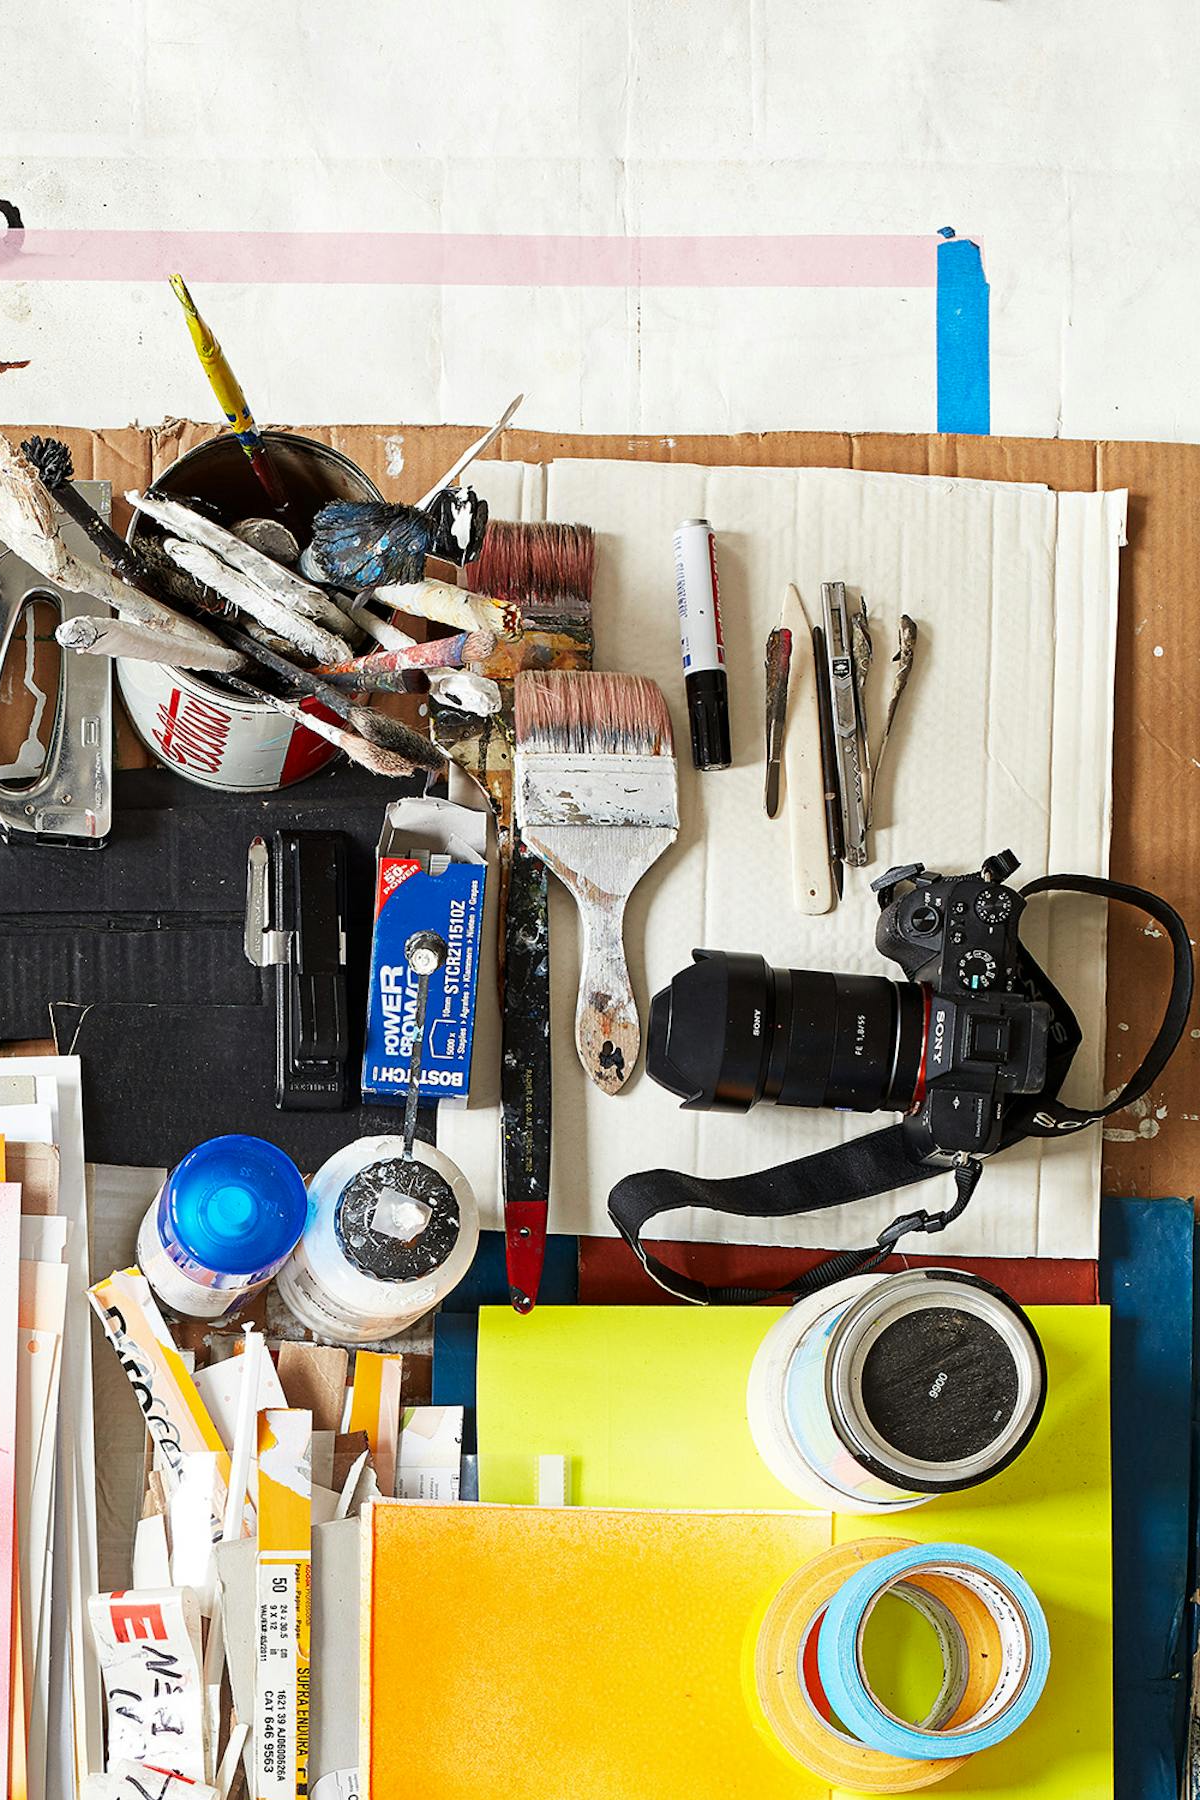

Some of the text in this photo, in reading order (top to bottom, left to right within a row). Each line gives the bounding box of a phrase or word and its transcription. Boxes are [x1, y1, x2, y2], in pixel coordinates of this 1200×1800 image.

[383, 864, 419, 895] POWER
[443, 899, 467, 995] STCR211510Z
[456, 1027, 468, 1054] Staples
[466, 914, 476, 939] Nieten
[379, 964, 404, 1056] POWER
[752, 1008, 763, 1037] SONY
[931, 1009, 947, 1065] SONY
[379, 1066, 464, 1088] BOSTTCH
[928, 1371, 949, 1399] 9900
[272, 1577, 287, 1593] 50
[280, 1604, 288, 1614] 24
[269, 1621, 278, 1631] 12
[280, 1622, 288, 1639] 30.5
[277, 1689, 287, 1710] 1621
[295, 1667, 310, 1757] SUPRA ENDURA
[263, 1690, 274, 1774] CAT 646 9563
[277, 1712, 286, 1725] 39
